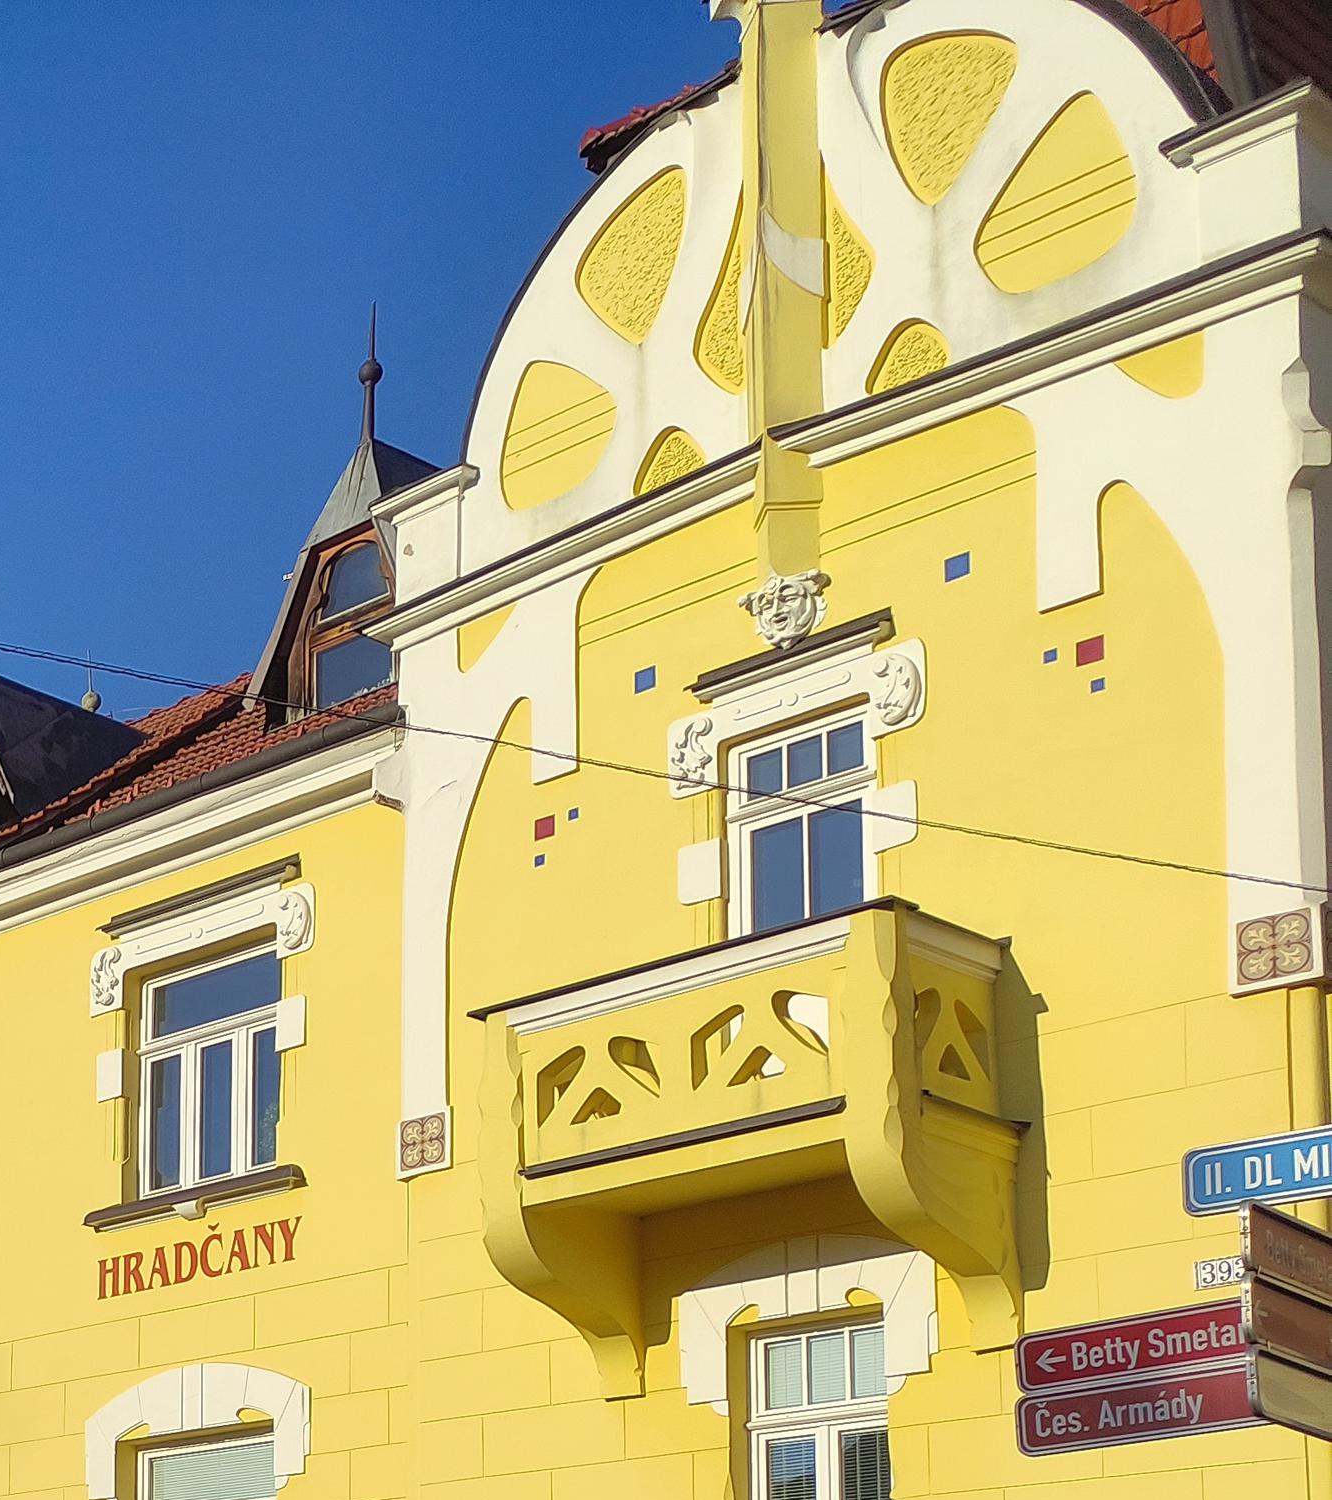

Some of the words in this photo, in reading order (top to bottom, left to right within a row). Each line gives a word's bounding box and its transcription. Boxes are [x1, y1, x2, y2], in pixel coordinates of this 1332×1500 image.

[1204, 1161, 1232, 1196] II.
[1244, 1153, 1283, 1190] DL
[96, 1214, 304, 1301] HRADČANY
[1071, 1334, 1142, 1372] Betty
[1036, 1402, 1090, 1438] Čes.
[1098, 1388, 1204, 1429] Armády
